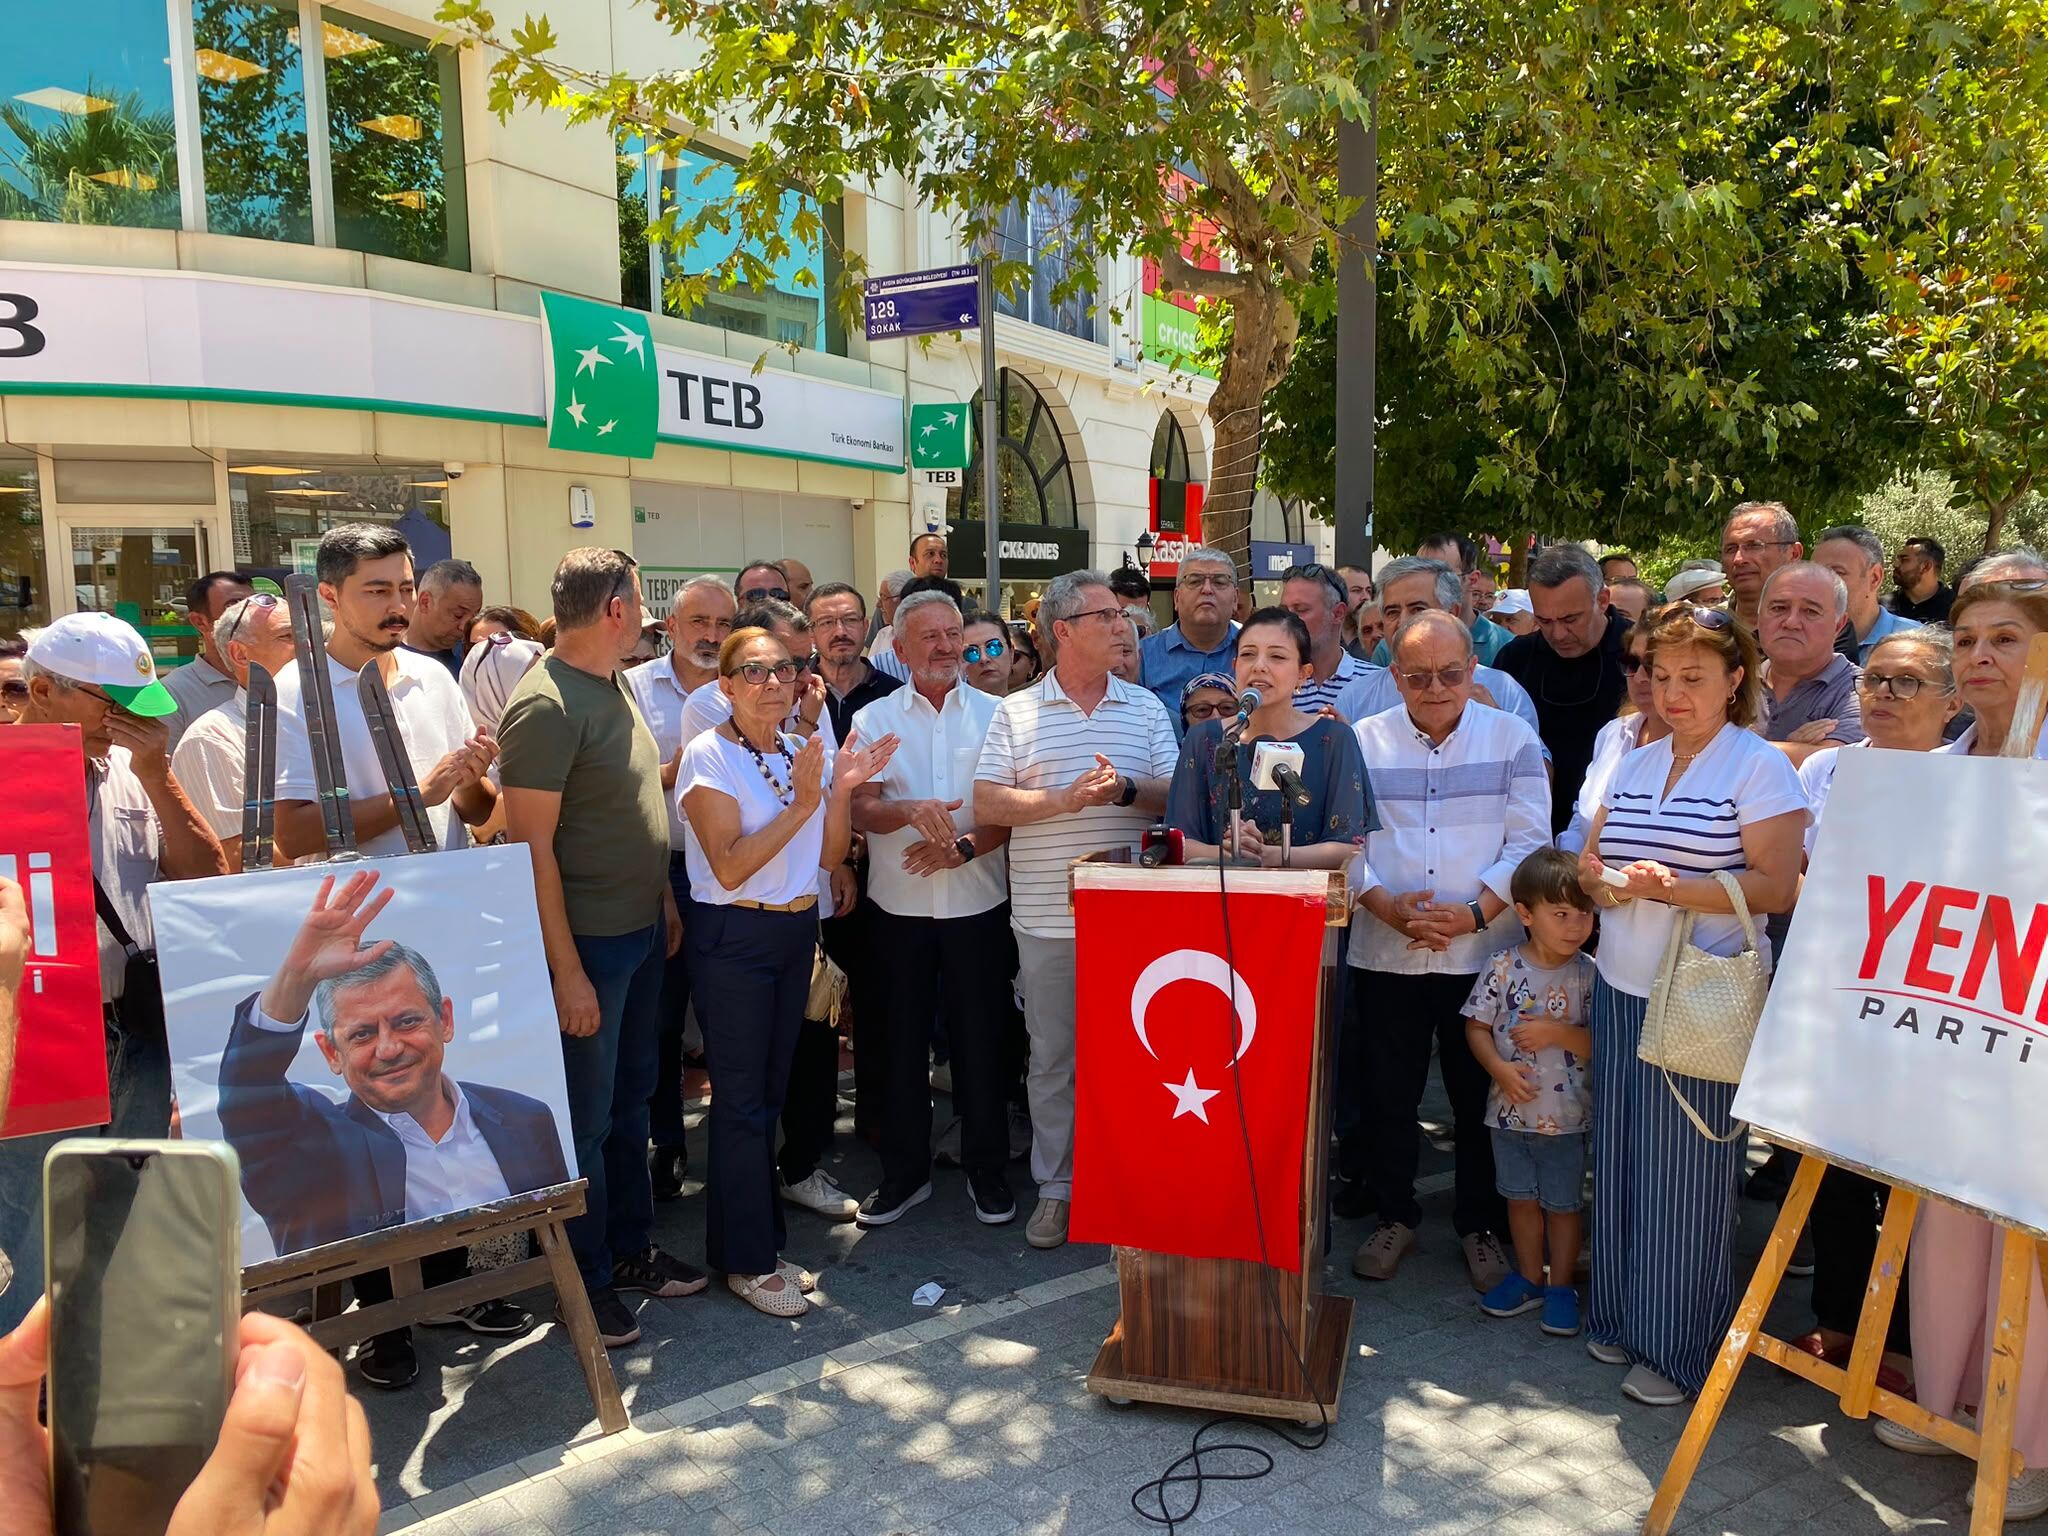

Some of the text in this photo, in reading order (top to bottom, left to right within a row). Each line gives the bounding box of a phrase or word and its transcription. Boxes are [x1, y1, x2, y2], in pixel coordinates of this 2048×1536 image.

[870, 300, 900, 320] 129.
[870, 322, 901, 335] SOKAK
[1158, 322, 1197, 351] crocs
[667, 369, 764, 430] TEB
[831, 432, 894, 452] Türk Ekonomi Bankası
[925, 471, 956, 483] TEB
[647, 512, 660, 520] TEB
[983, 540, 1060, 560] CK&JONES
[1268, 550, 1293, 571] mavi
[1858, 874, 2048, 1026] YEN
[1858, 996, 2034, 1064] PARTi
